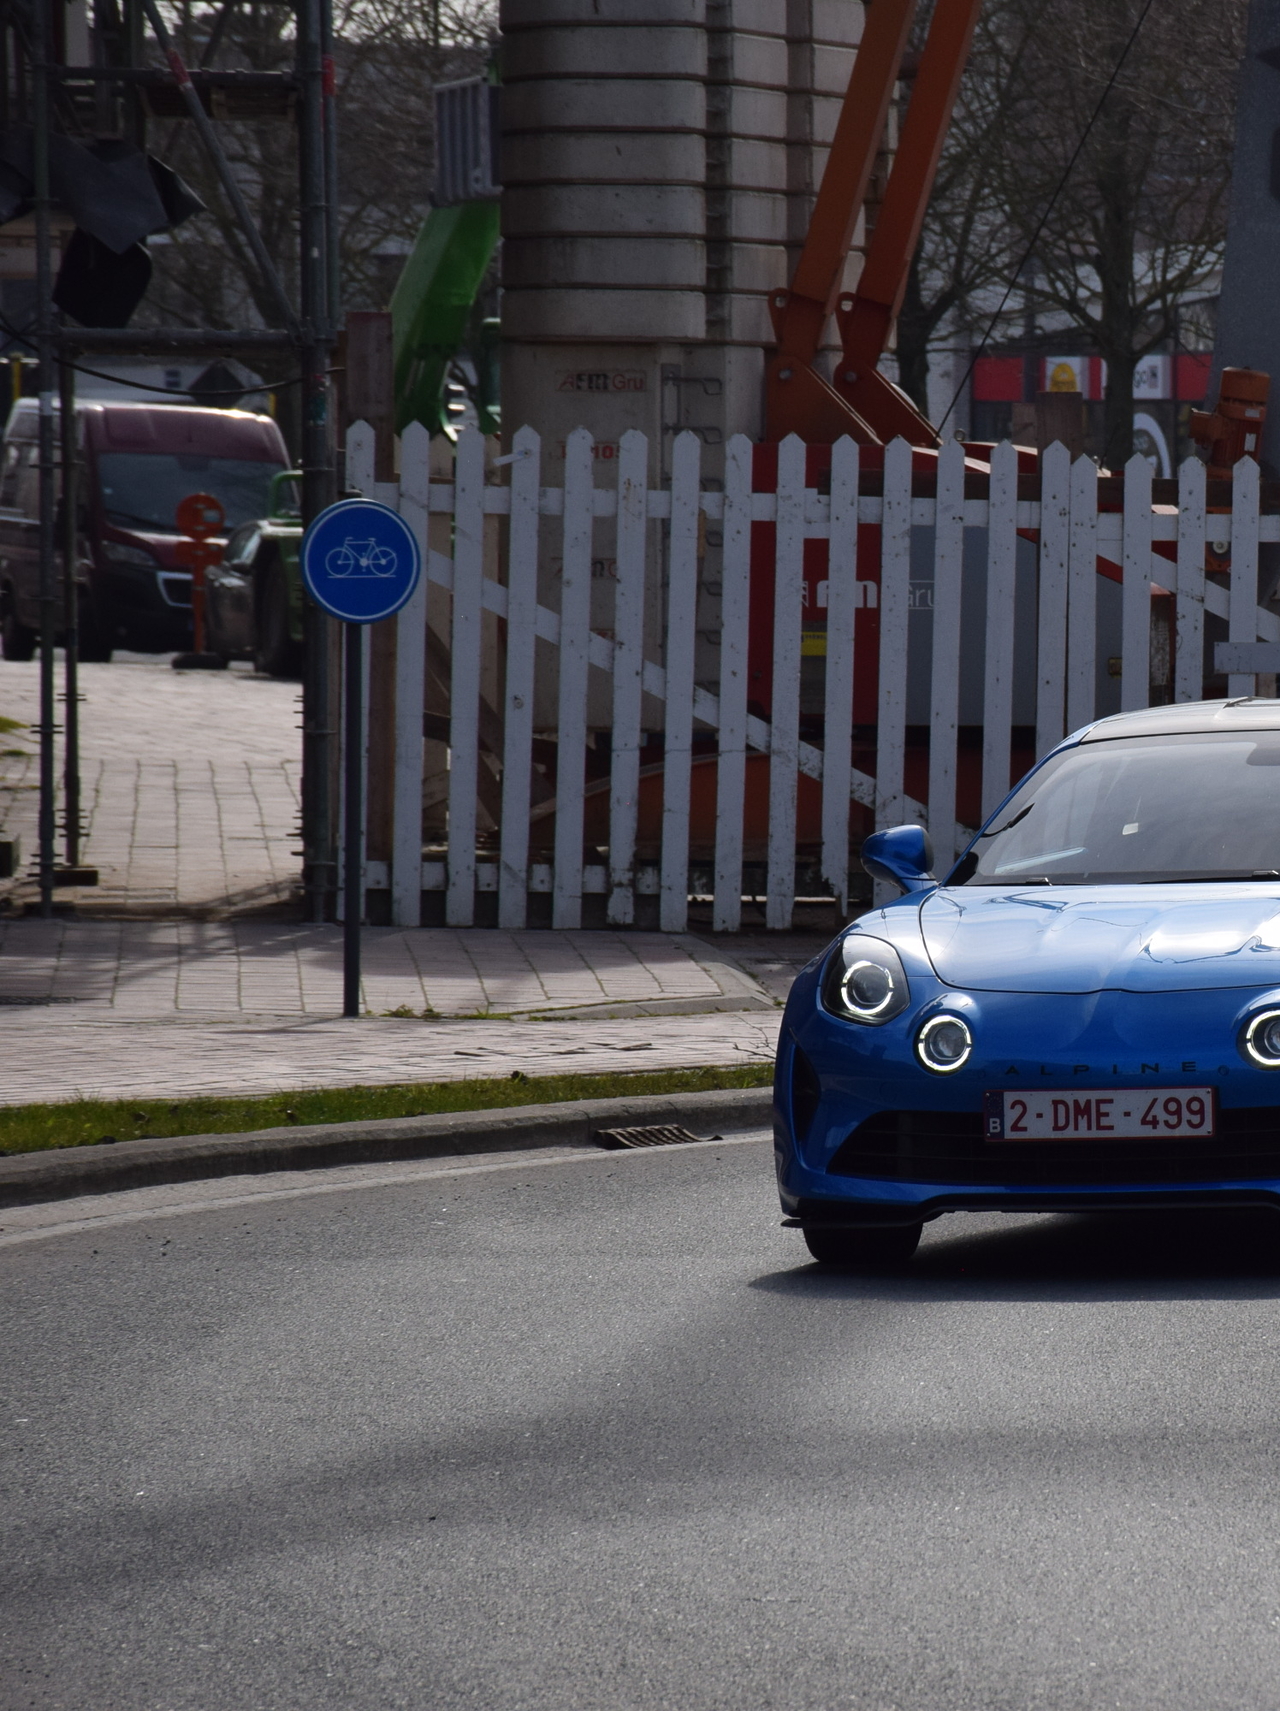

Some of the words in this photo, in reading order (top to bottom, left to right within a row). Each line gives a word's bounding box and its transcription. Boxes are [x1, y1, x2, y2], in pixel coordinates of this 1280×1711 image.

[612, 373, 644, 390] Gru
[1005, 1061, 1196, 1075] ALPINE
[1009, 1096, 1205, 1132] 2-DME-499
[989, 1117, 1001, 1133] B
